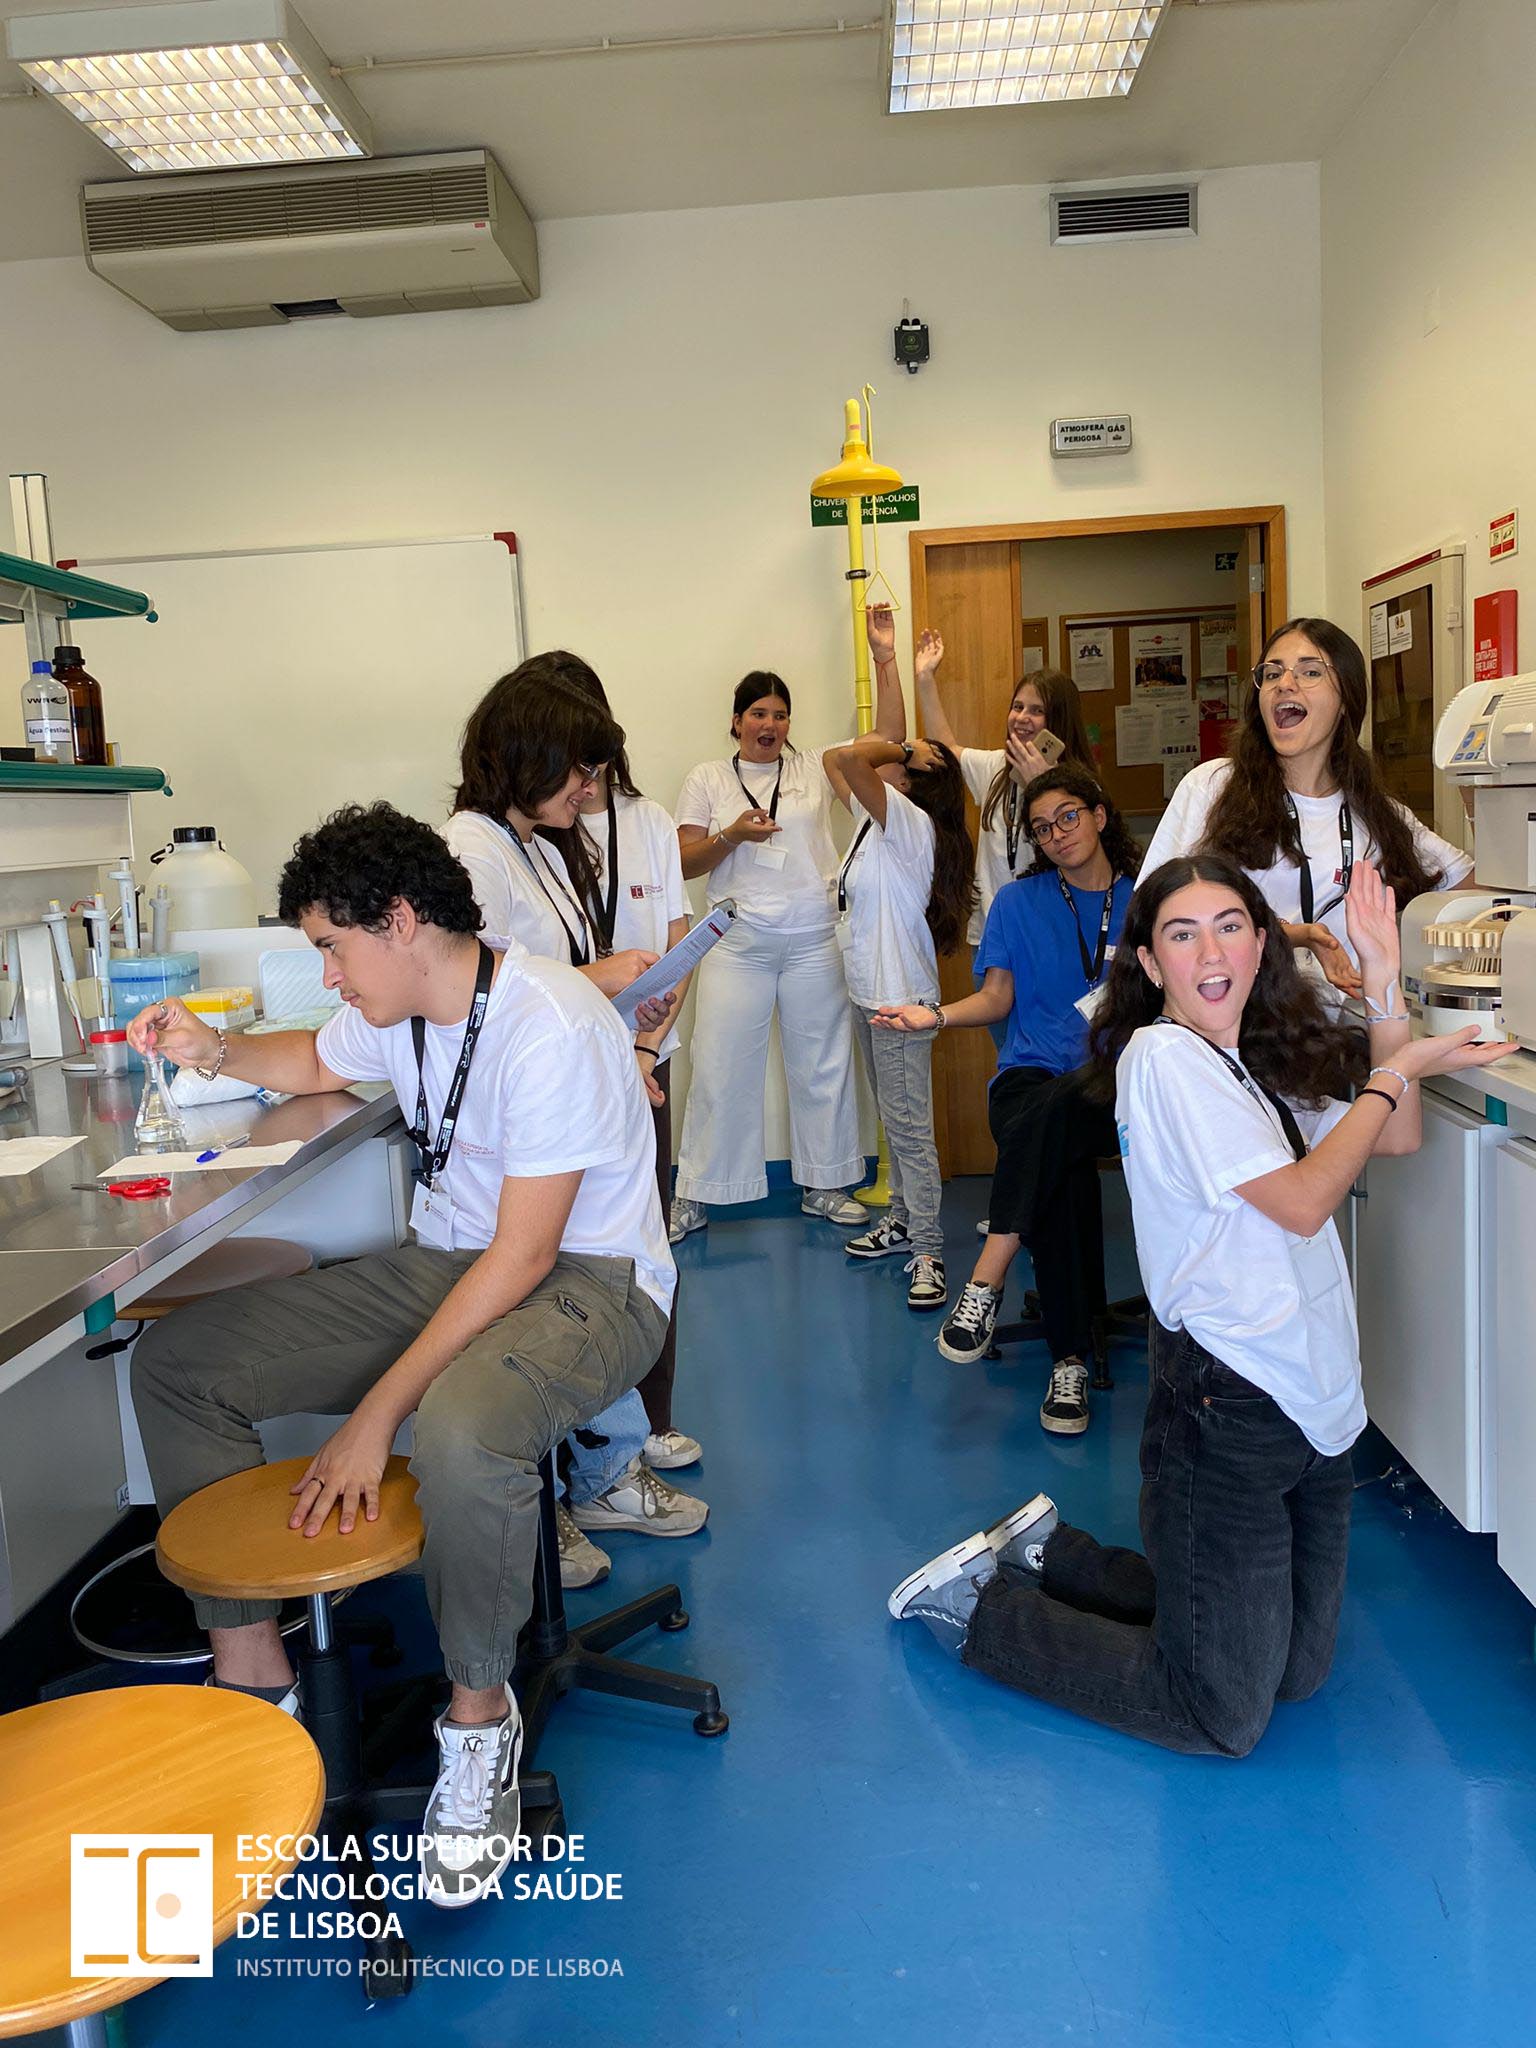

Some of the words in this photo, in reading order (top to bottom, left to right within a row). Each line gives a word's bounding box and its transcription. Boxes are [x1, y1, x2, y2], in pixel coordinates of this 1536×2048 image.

[1060, 424, 1104, 433] ATMOSFERA
[1107, 423, 1126, 433] GÁS
[1064, 434, 1102, 443] PERIGOSA
[813, 498, 848, 507] CHUVEIR
[832, 510, 843, 518] DE
